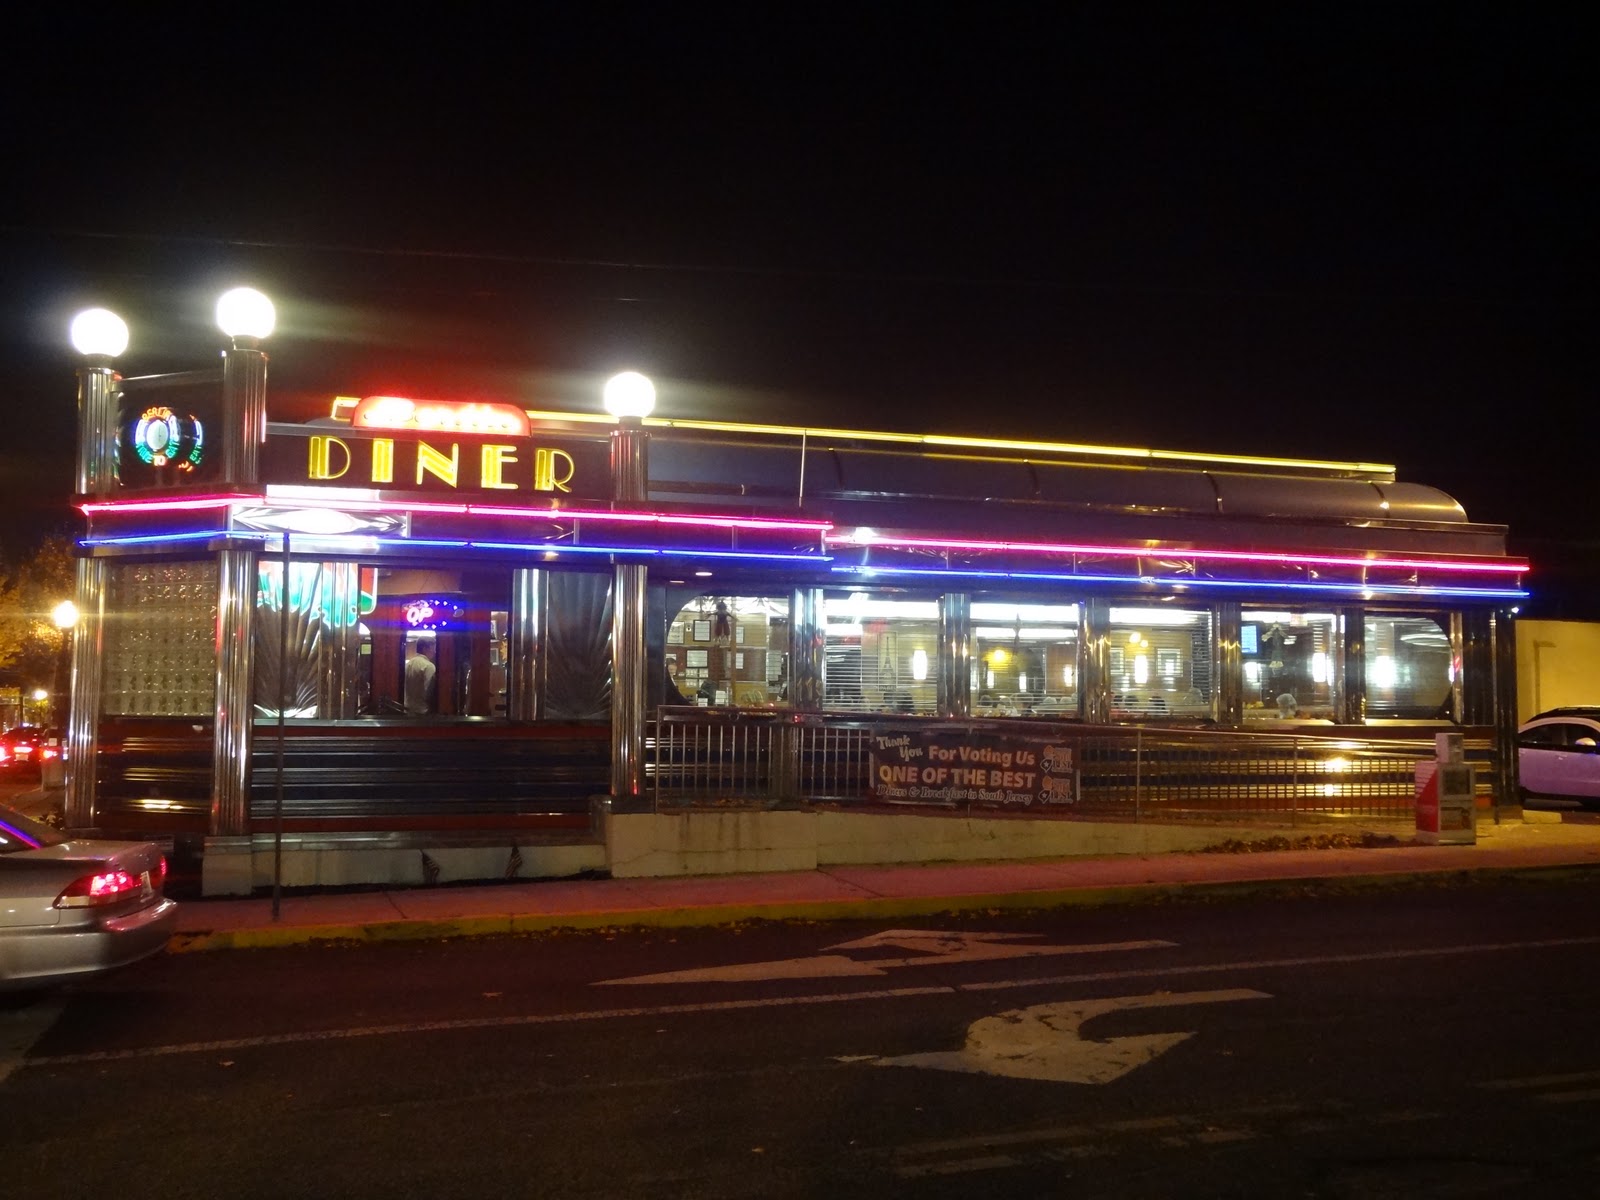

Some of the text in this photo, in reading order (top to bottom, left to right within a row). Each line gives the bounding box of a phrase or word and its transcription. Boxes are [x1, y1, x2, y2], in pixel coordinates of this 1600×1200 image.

[309, 436, 575, 492] DINER
[876, 735, 910, 749] Thank
[900, 746, 923, 761] You
[929, 746, 957, 761] For
[959, 747, 1012, 767] Voting
[1016, 751, 1035, 765] Us
[879, 765, 1036, 788] ONE OF THE BEST
[967, 789, 978, 799] in
[978, 790, 1004, 802] South
[1004, 791, 1034, 806] Jersey
